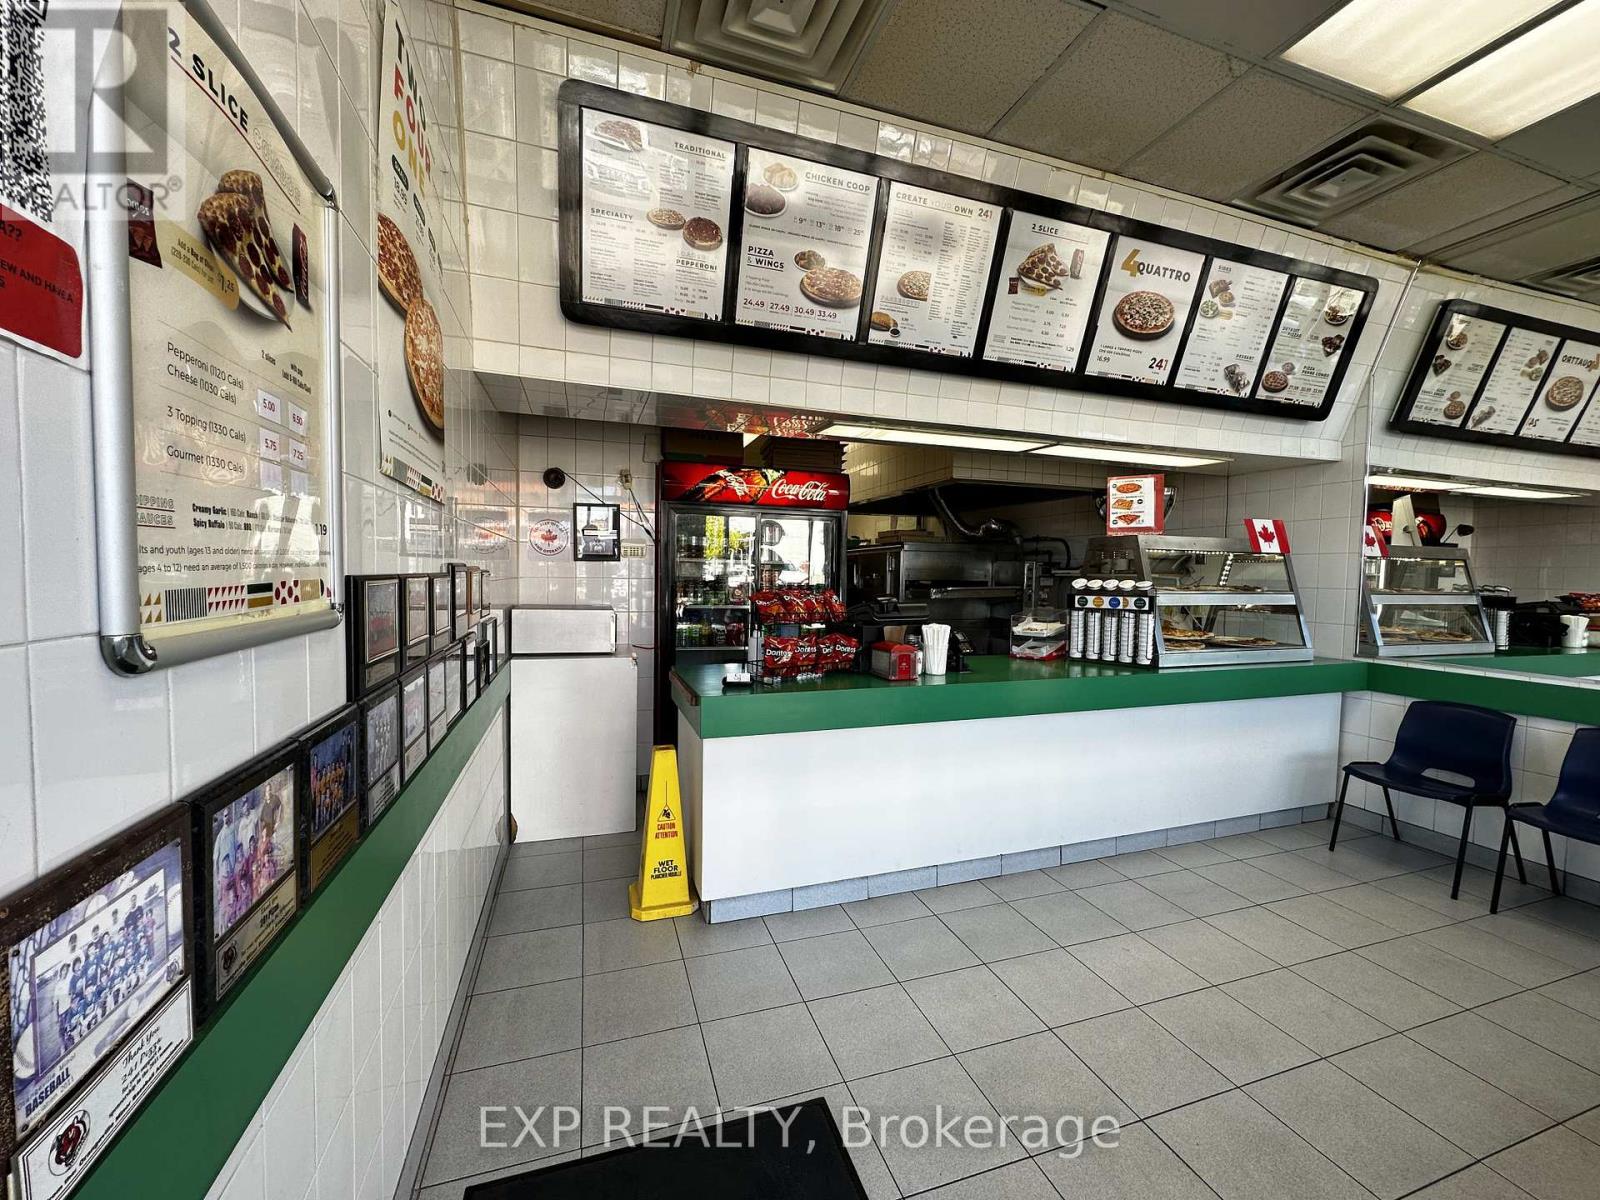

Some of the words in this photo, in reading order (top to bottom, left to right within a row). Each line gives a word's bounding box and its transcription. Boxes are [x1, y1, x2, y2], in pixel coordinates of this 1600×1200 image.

[167, 27, 182, 59] 2
[192, 53, 249, 134] SLICE
[673, 141, 726, 159] TRADITIONAL
[805, 171, 844, 187] CHICKEN
[846, 181, 870, 193] COOP
[896, 192, 928, 205] CREATE
[954, 205, 974, 215] OWN
[590, 207, 633, 221] SPECIALTY
[1038, 224, 1059, 236] SLICE
[747, 245, 775, 257] PIZZA
[675, 258, 718, 271] PEPPERONI
[755, 258, 785, 269] WINGS
[1120, 248, 1141, 277] 4
[1137, 262, 1191, 282] QUATTRO
[20, 269, 43, 286] AND
[743, 298, 765, 308] 24.49
[769, 302, 790, 312] 27.49
[794, 306, 815, 316] 30.49
[817, 309, 837, 319] 33.49
[167, 341, 209, 373] Pepperoni
[210, 364, 226, 381] (1120
[227, 373, 244, 391] Cals)
[1148, 357, 1169, 371] 241
[167, 364, 199, 386] Cheese
[199, 379, 219, 396] (1030
[219, 386, 237, 405] Cals)
[263, 398, 276, 413] 5.00
[167, 405, 174, 418] 3
[174, 408, 208, 432] Topping
[208, 419, 228, 437] (1330
[229, 427, 246, 444] Cals)
[264, 438, 277, 452] 5.75
[166, 445, 204, 465] Gourmet
[205, 455, 226, 470] (1330
[227, 460, 244, 474] Cals)
[771, 478, 828, 501] Coca-Cola
[192, 503, 211, 516] Creamy
[212, 505, 227, 516] Garlic
[137, 512, 174, 526] AUCES
[193, 518, 207, 530] Spicy
[208, 519, 225, 530] Buffalo
[149, 546, 164, 555] and
[165, 545, 186, 557] youth
[183, 562, 200, 572] need
[766, 648, 792, 657] Doritos
[836, 644, 856, 653] Doritos
[656, 822, 676, 831] CAUTION
[654, 830, 678, 840] ATTENTION
[653, 865, 678, 874] FLOOR
[658, 859, 674, 867] WET
[25, 1066, 71, 1119] BASEBALL
